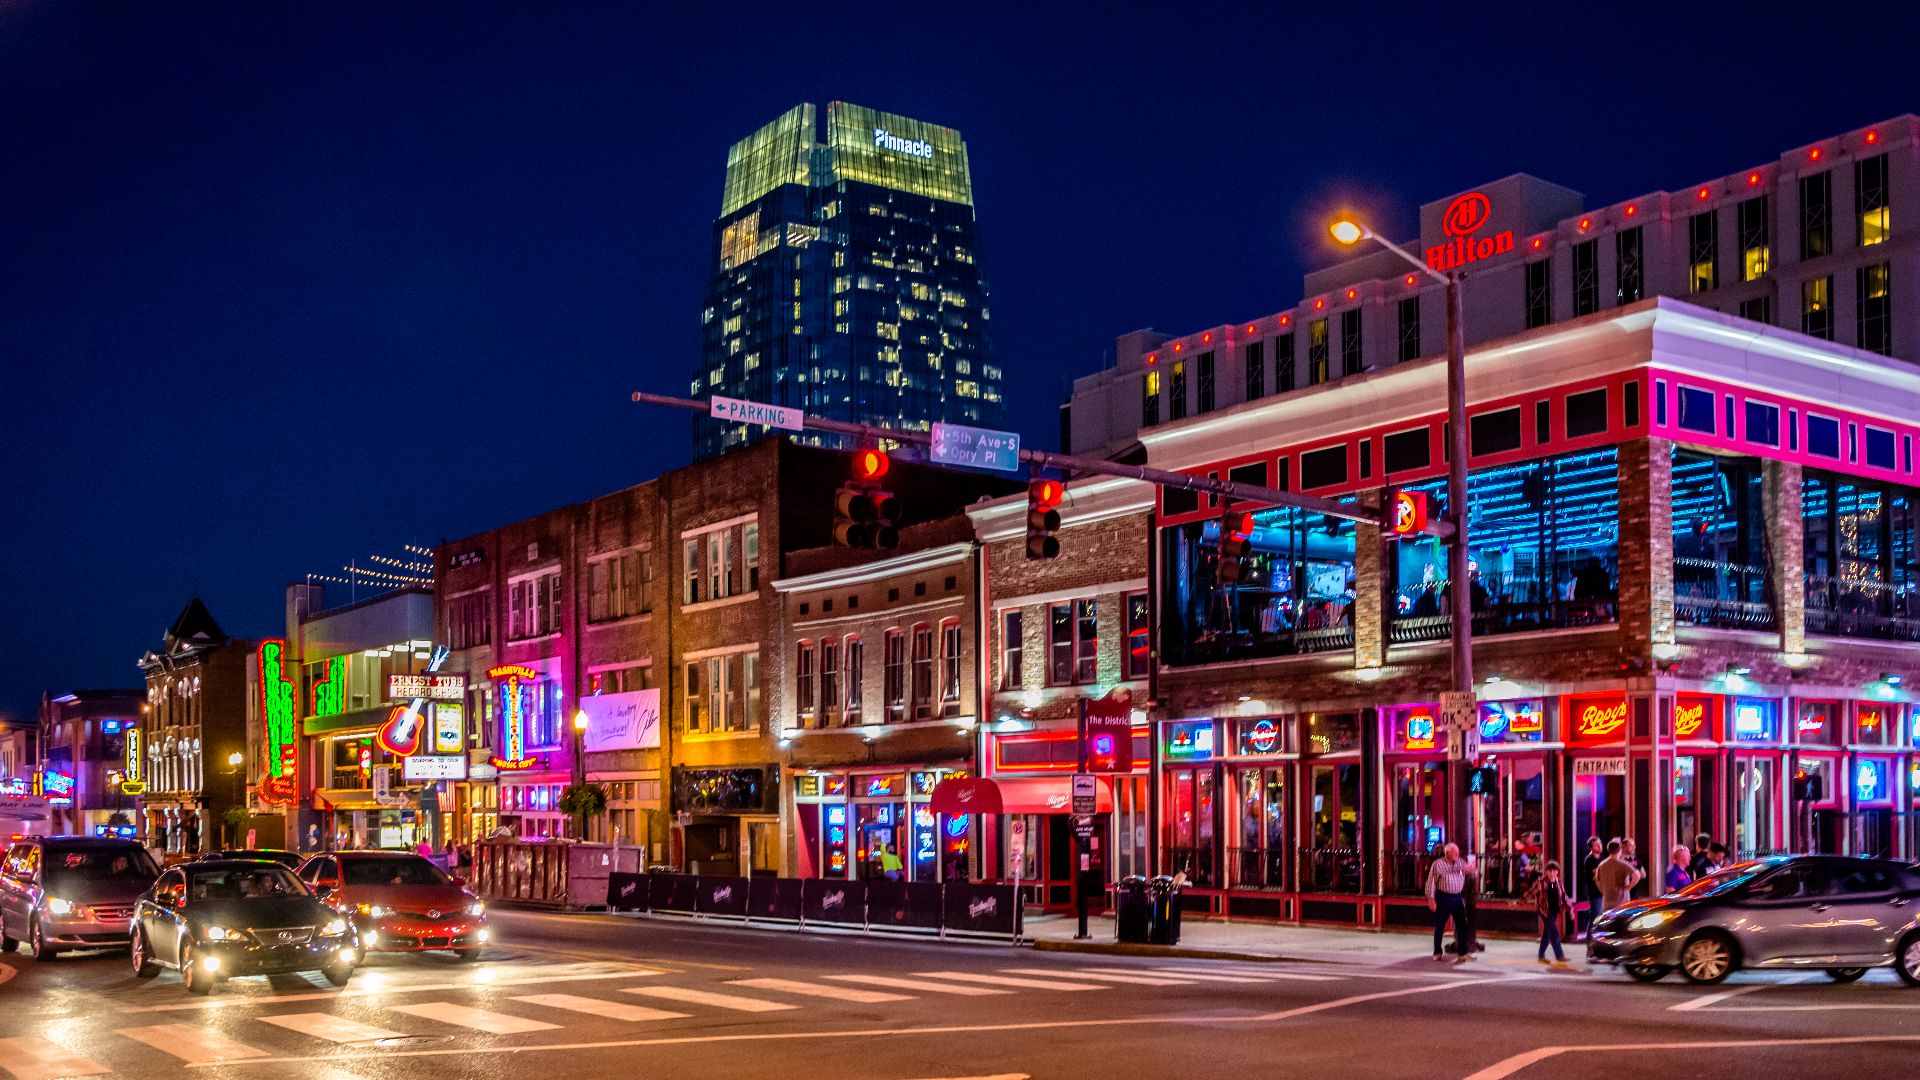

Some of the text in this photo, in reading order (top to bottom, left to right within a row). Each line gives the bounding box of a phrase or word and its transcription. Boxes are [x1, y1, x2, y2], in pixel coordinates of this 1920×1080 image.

[874, 127, 932, 159] Pinnacle
[1425, 230, 1515, 273] Hilton
[730, 402, 785, 425] PARKING
[951, 446, 996, 463] Opry Pl
[489, 665, 536, 679] NASHVILLE
[391, 674, 464, 687] ERNEST TUBB
[396, 687, 462, 698] RECORD SHOP
[508, 675, 519, 761] CROSSROADS
[1089, 714, 1131, 726] The Distric
[1442, 711, 1456, 726] OK
